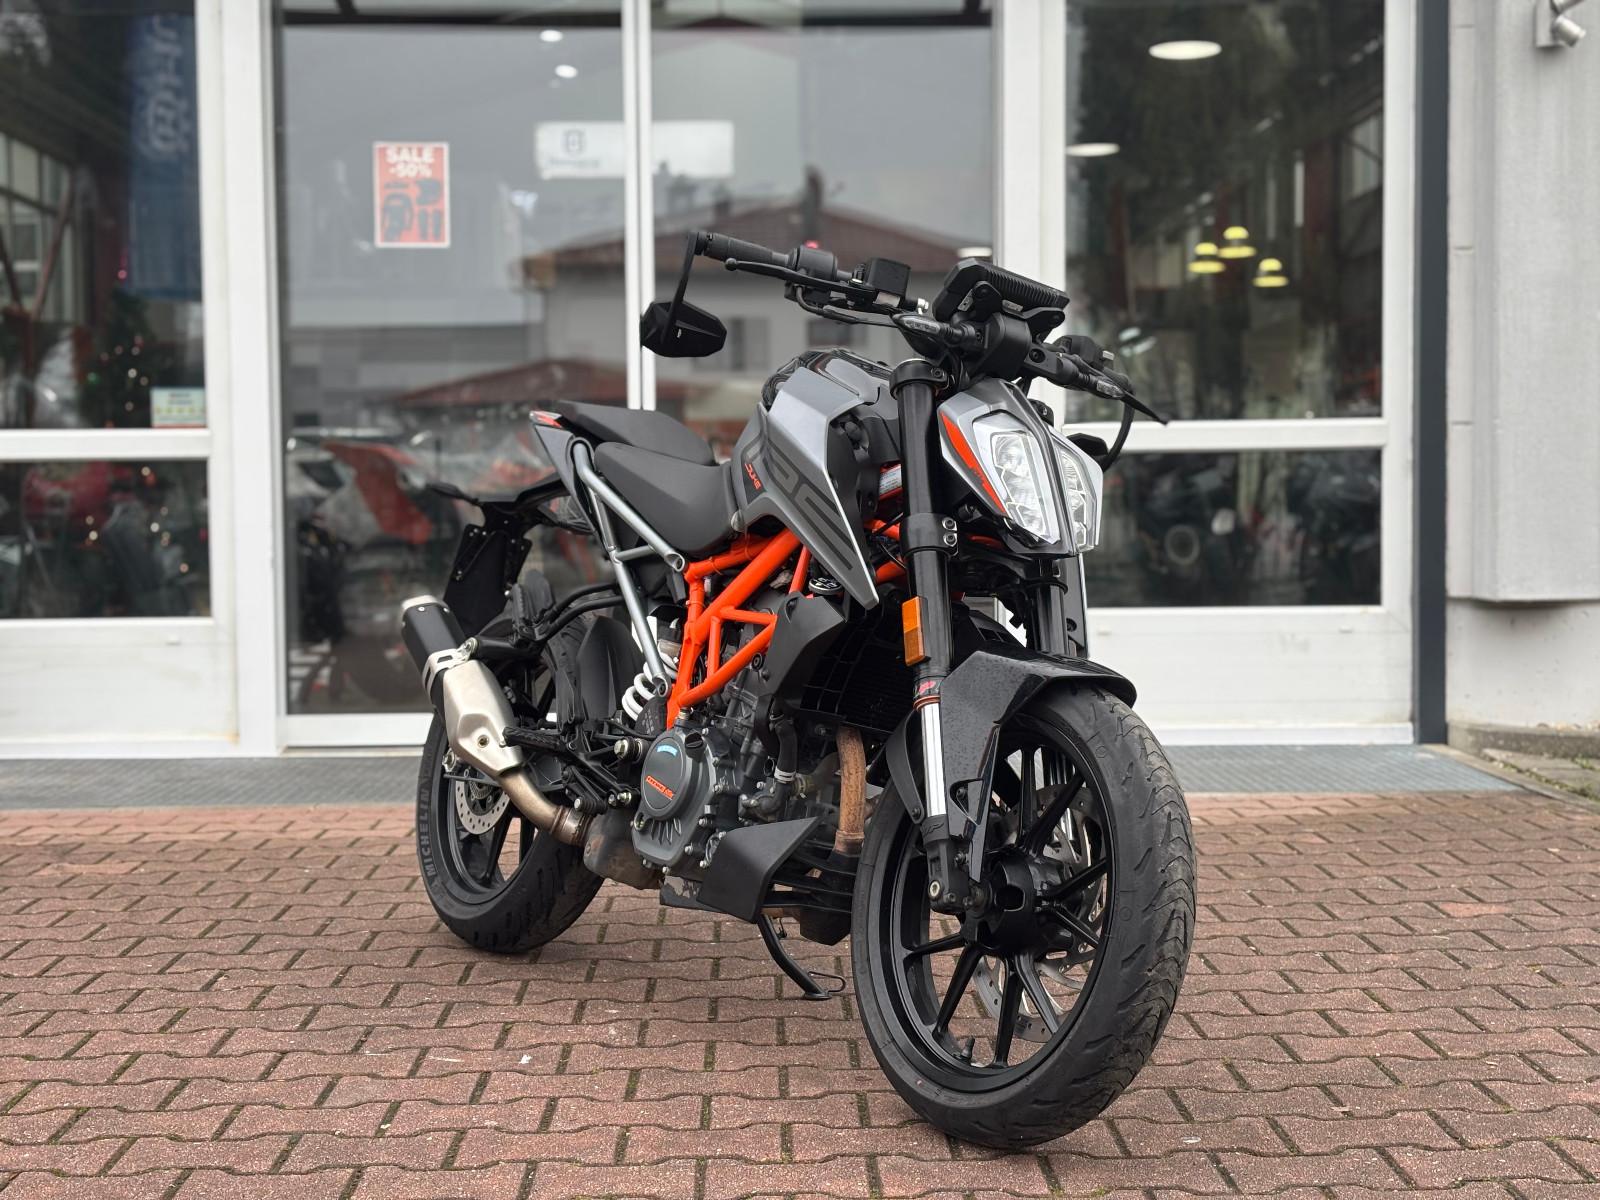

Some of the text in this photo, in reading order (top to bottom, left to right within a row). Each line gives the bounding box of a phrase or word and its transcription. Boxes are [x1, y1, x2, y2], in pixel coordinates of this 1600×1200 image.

[385, 145, 434, 163] SALE
[744, 463, 762, 490] DUKE
[419, 788, 437, 877] MICHELIN
